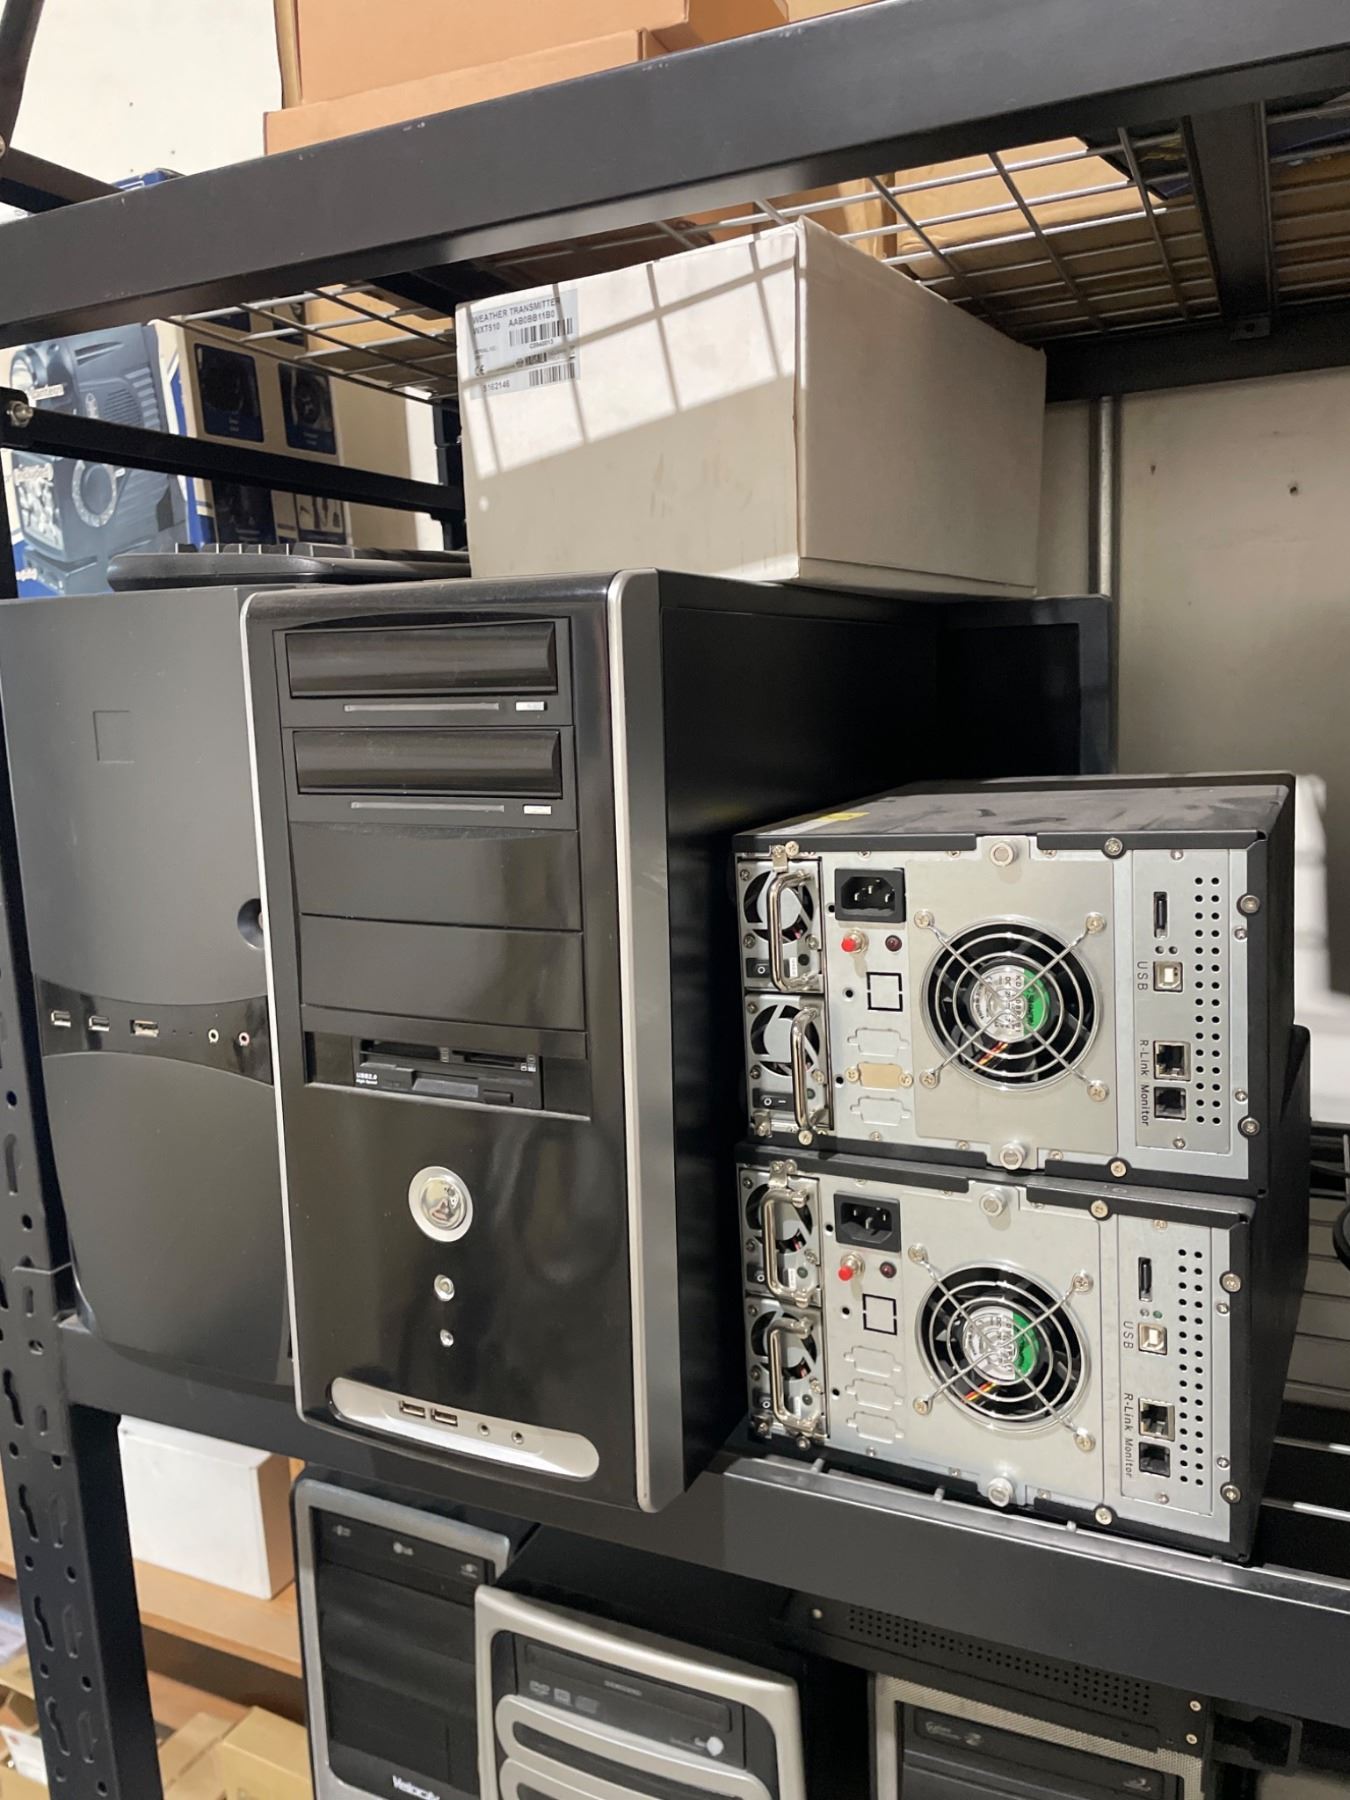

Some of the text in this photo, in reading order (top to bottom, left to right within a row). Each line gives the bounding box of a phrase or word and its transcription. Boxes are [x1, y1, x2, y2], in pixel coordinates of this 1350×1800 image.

[473, 297, 560, 324] WEATHER TRANSMITTER
[1136, 961, 1149, 991] USB
[1139, 1040, 1150, 1077] R-Link
[1140, 1084, 1150, 1127] Monitor
[1123, 1321, 1134, 1350] USB
[1123, 1393, 1134, 1431] R-Link
[1124, 1438, 1134, 1479] Monitor
